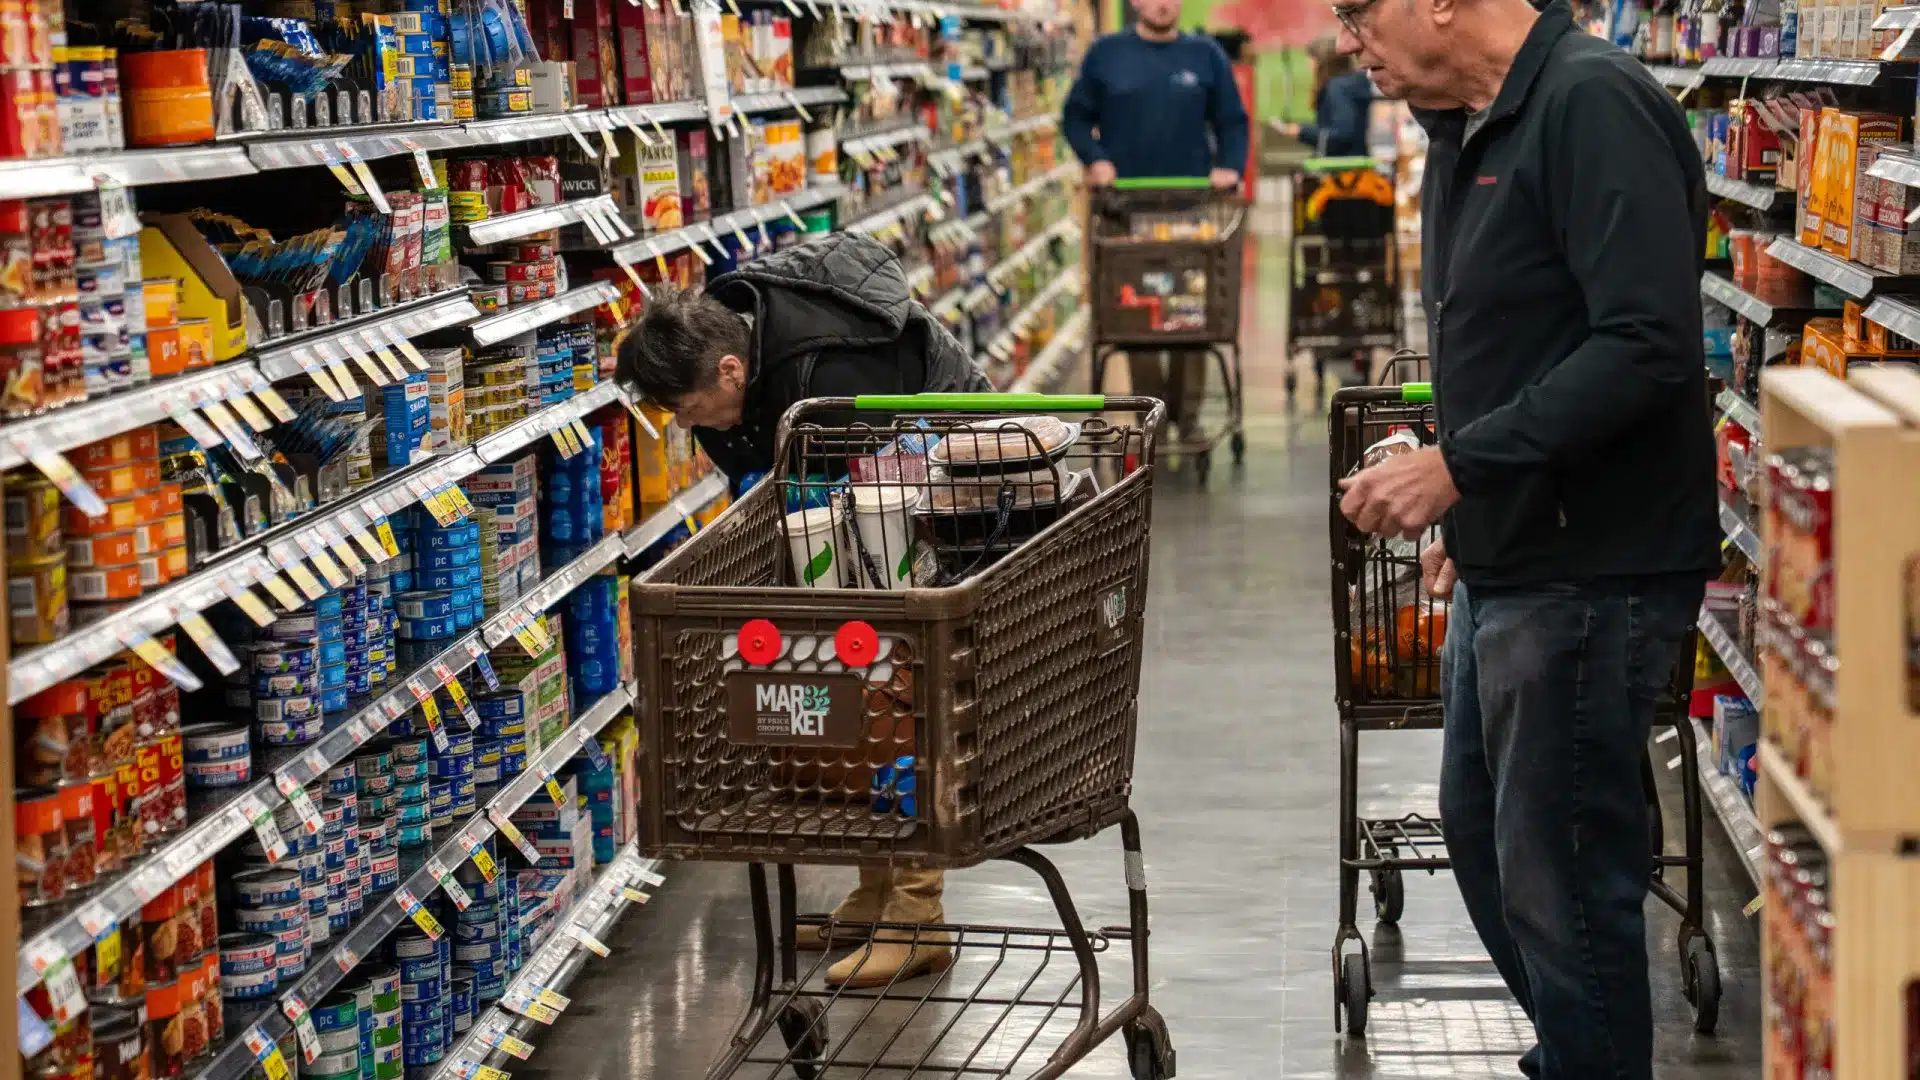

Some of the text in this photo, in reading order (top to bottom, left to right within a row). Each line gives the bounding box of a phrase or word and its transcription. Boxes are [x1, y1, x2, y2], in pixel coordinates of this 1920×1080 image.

[422, 40, 430, 50] pc
[641, 145, 673, 161] PANKO
[409, 398, 427, 413] SNACK
[432, 537, 443, 546] pc
[435, 557, 447, 567] pc
[435, 577, 447, 587] pc
[430, 625, 442, 636] pc
[755, 684, 804, 712] MAR
[791, 711, 827, 735] KET
[757, 725, 790, 733] CHOPPER
[320, 1014, 333, 1026] pc
